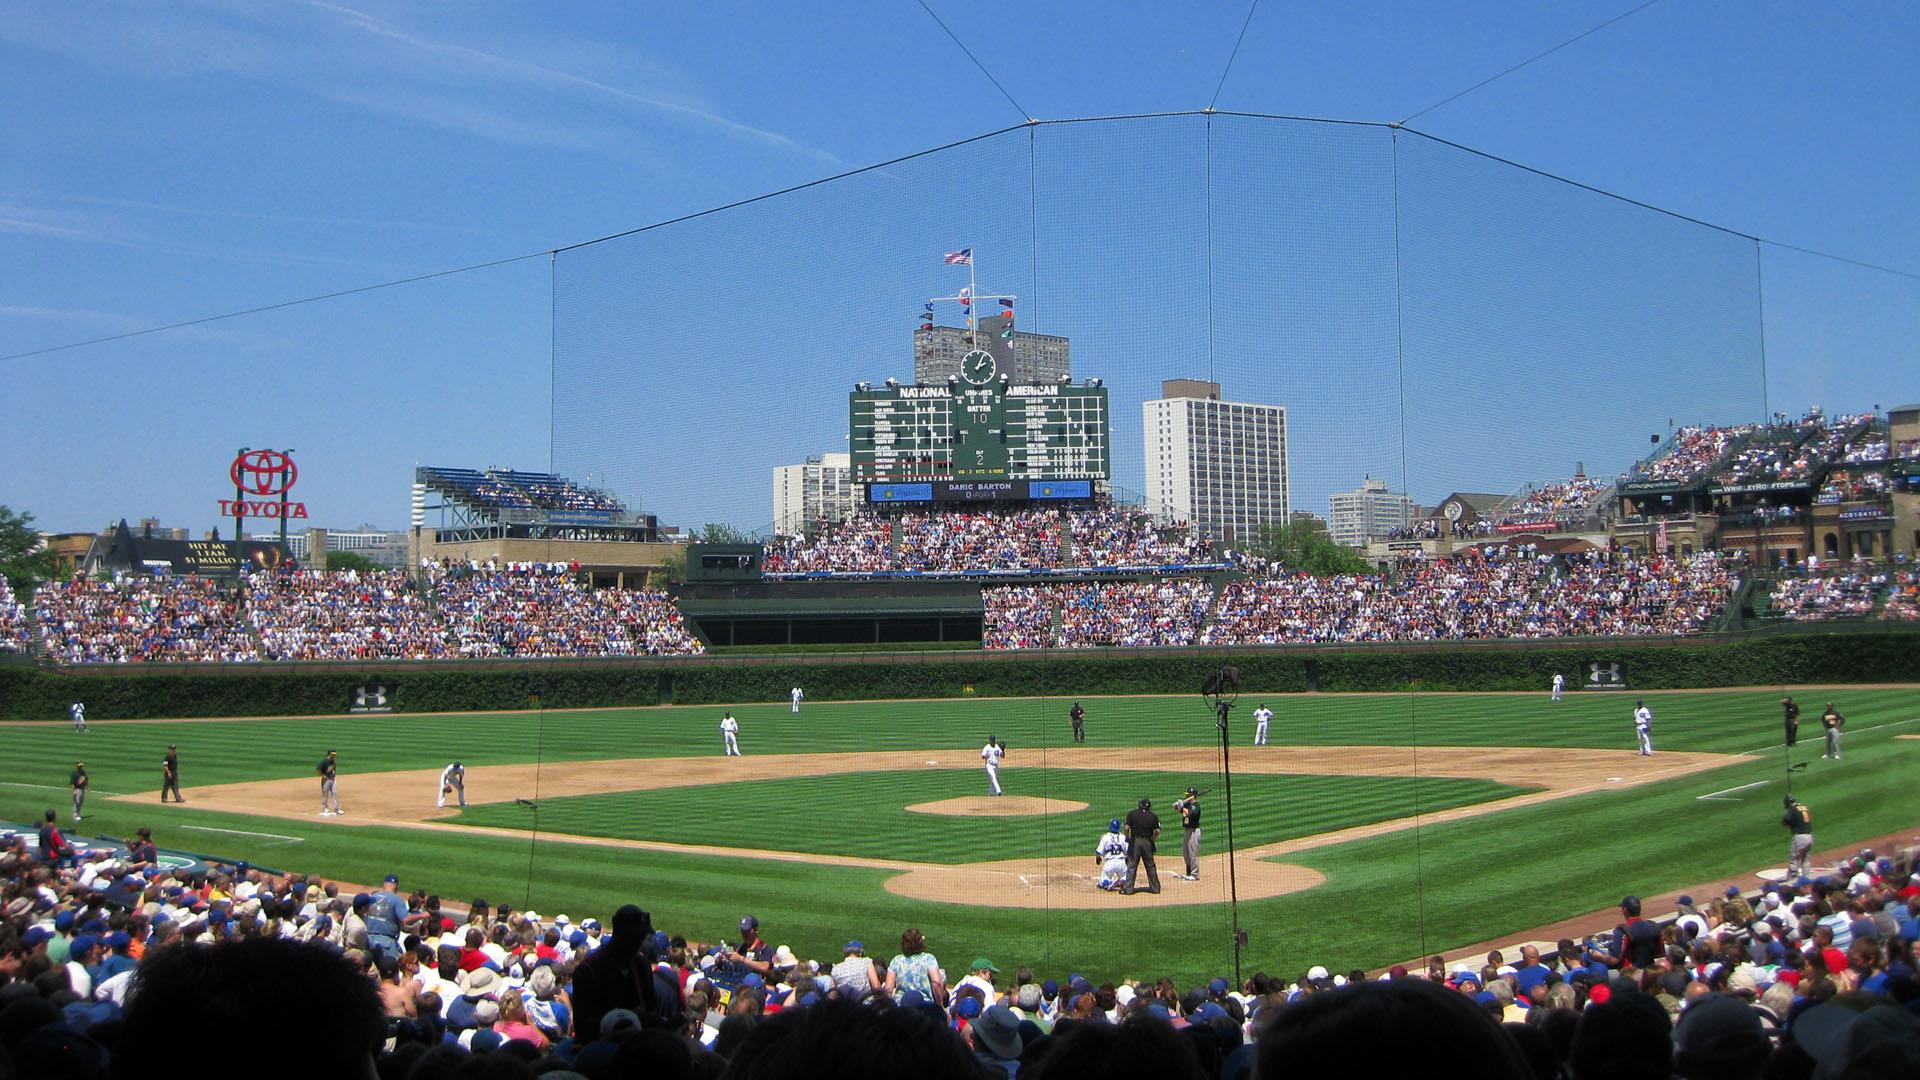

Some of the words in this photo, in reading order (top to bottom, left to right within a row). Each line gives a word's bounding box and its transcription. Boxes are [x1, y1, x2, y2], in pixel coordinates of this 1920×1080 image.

[900, 387, 952, 398] NATIONAL
[1006, 385, 1058, 396] AMERICAN
[973, 413, 987, 423] 10
[976, 454, 984, 465] 2
[217, 499, 308, 518] TOYOTA
